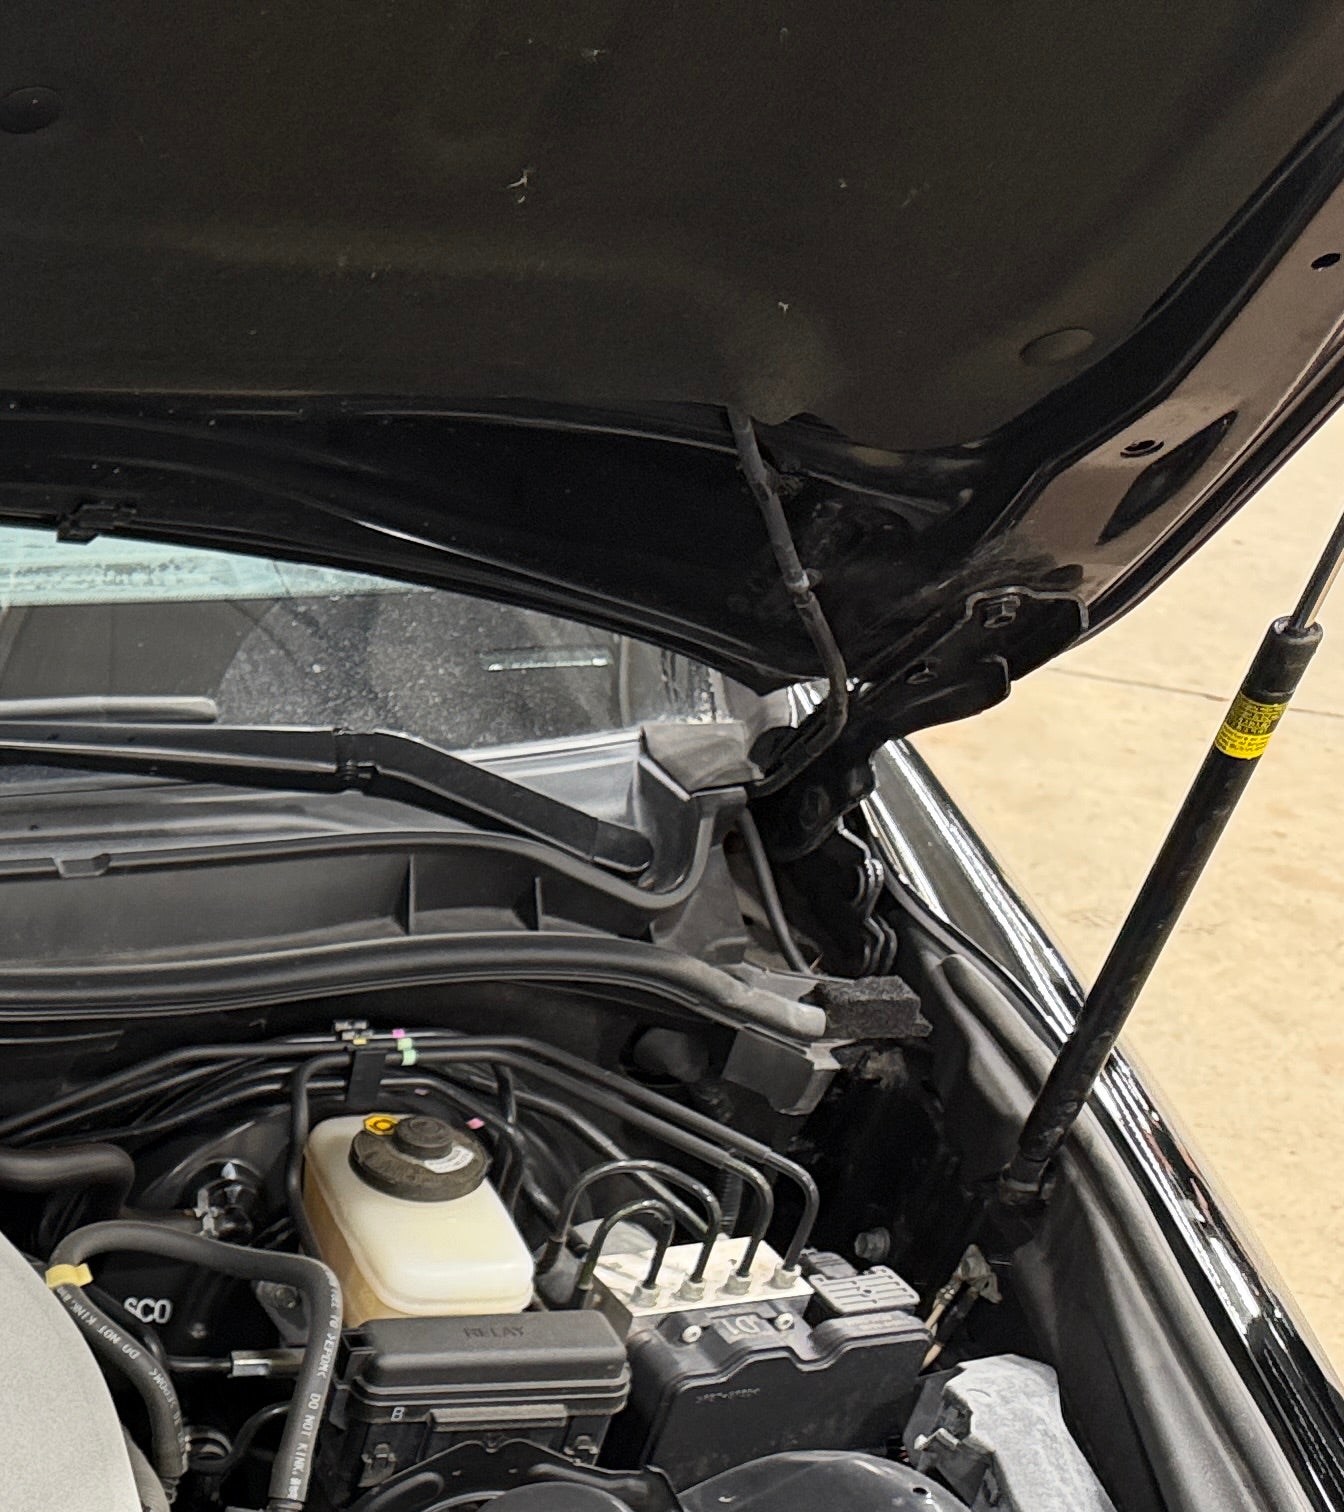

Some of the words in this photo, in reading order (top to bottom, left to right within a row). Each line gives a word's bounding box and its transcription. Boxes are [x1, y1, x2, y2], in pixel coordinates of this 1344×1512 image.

[96, 1325, 122, 1345] NOT
[464, 1326, 525, 1339] RELAY
[122, 1344, 140, 1360] DO
[308, 1393, 321, 1410] DO
[301, 1414, 316, 1436] NOT
